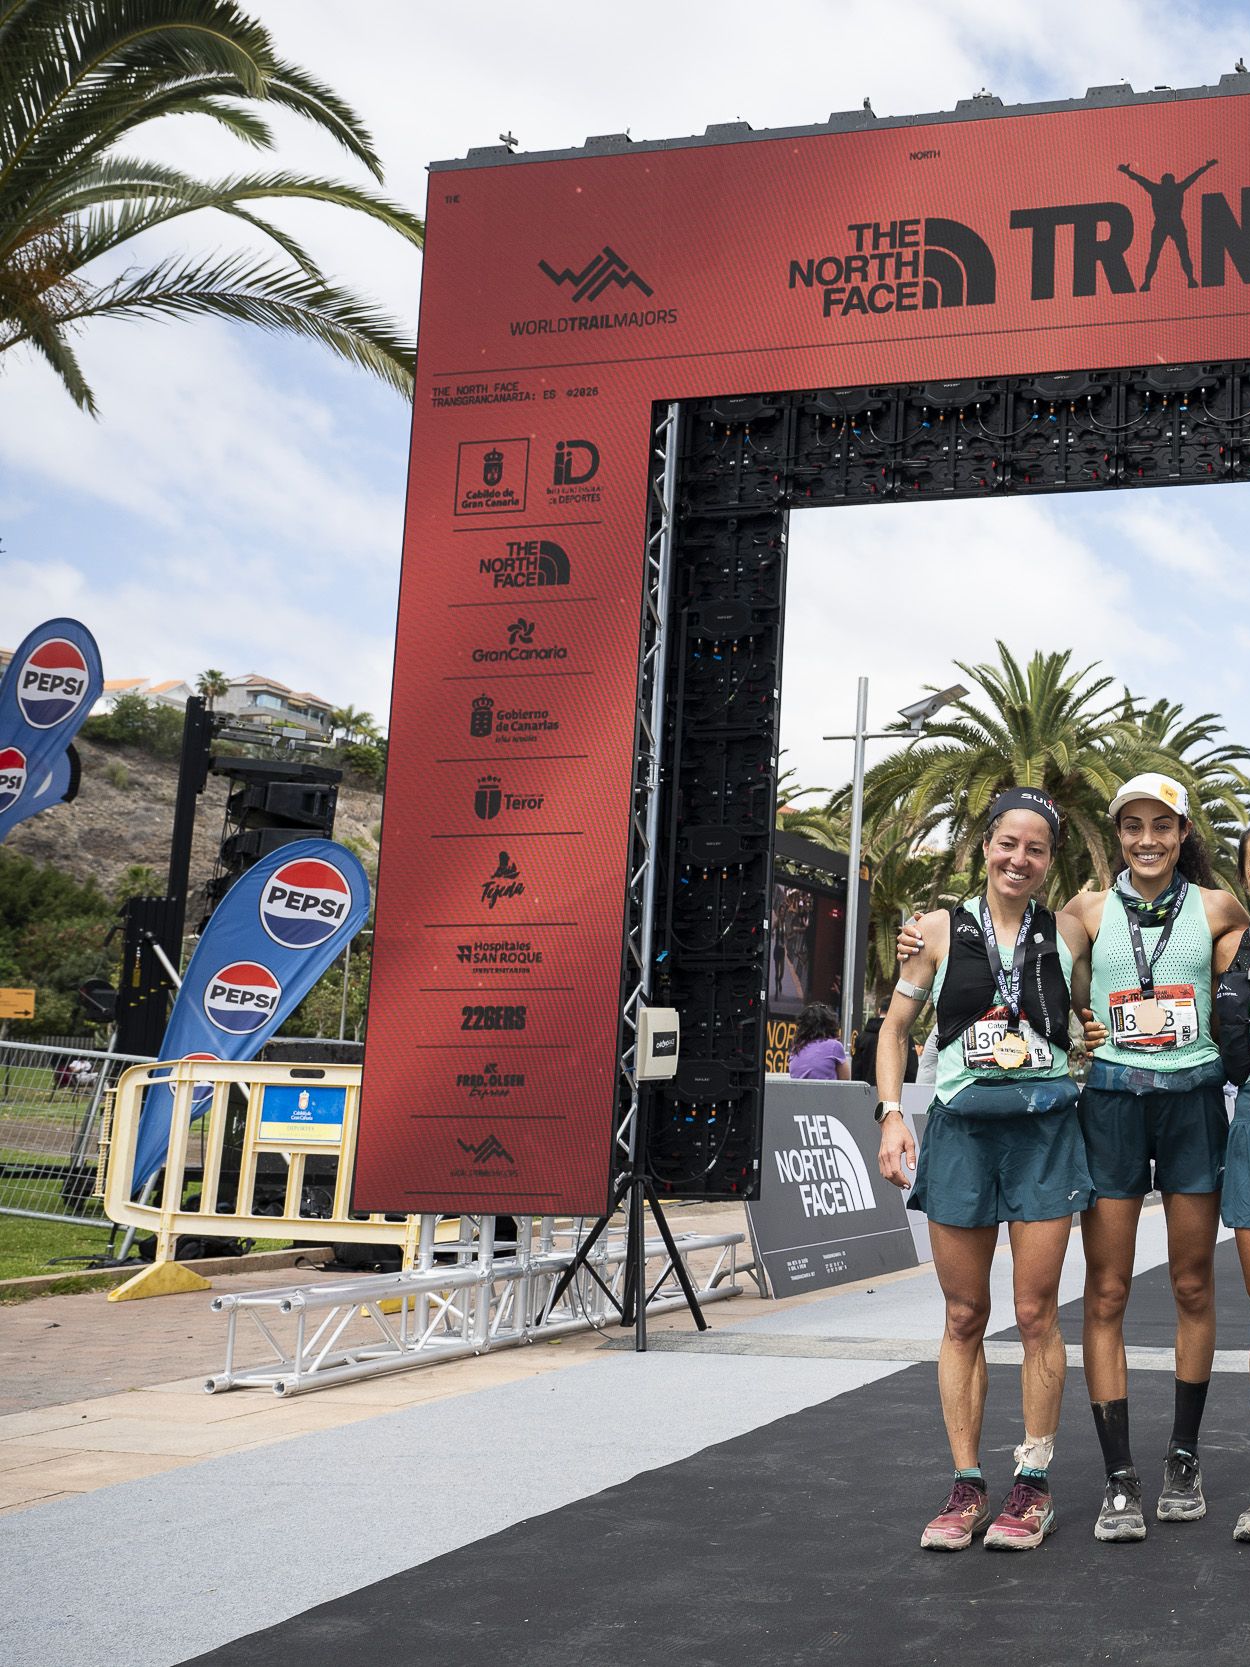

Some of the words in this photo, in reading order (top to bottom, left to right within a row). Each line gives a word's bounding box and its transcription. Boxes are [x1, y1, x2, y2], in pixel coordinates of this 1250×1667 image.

[909, 149, 941, 161] NORTH
[445, 195, 460, 204] THE
[848, 218, 921, 252] THE
[789, 247, 919, 289] NORTH
[822, 281, 919, 318] FACE
[509, 309, 678, 336] WORLDTRAILMAJORS
[432, 386, 450, 397] THE
[456, 383, 488, 395] NORTH
[493, 381, 520, 392] FACE
[543, 389, 556, 400] ES
[465, 490, 500, 500] Cabildo
[502, 488, 514, 498] de
[461, 499, 483, 509] Gran
[485, 497, 519, 508] Canaria
[506, 541, 539, 557] THE
[479, 557, 538, 574] NORTH
[493, 572, 537, 588] FACE
[23, 670, 84, 696] PEPSI
[496, 709, 549, 721] Gobierno
[495, 721, 509, 732] de
[510, 719, 559, 732] Canarias
[0, 774, 22, 790] PSI
[503, 793, 544, 810] Teror
[1020, 793, 1060, 825] SUUN
[267, 885, 345, 919] PEPSI
[474, 940, 531, 952] Hospitales
[473, 952, 497, 963] SAN
[500, 951, 542, 963] ROQUE
[209, 984, 278, 1010] PEPSI
[461, 1006, 527, 1030] 226ERS
[793, 1115, 830, 1146] THE
[774, 1148, 840, 1184] NORTH
[799, 1180, 847, 1218] FACE
